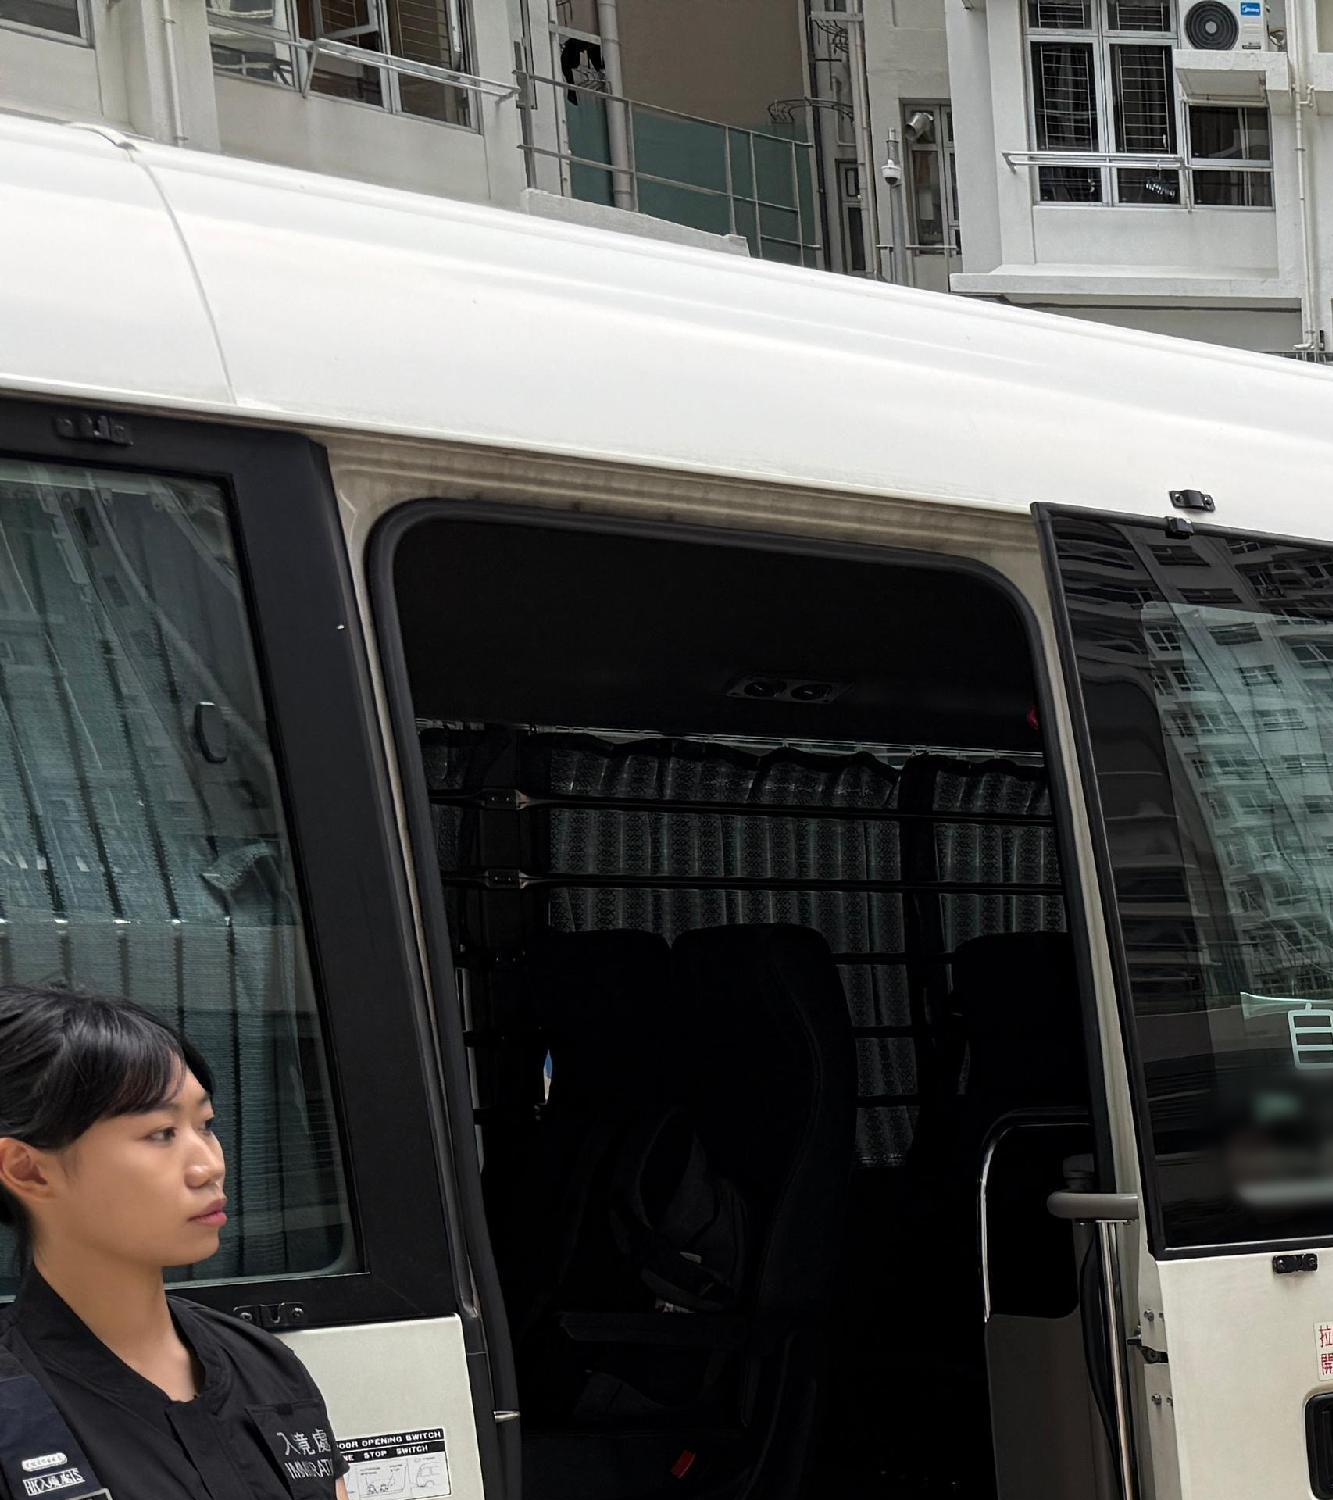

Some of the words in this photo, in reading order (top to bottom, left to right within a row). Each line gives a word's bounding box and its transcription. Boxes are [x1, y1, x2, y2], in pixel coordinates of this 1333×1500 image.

[337, 1439, 360, 1451] OOR
[362, 1435, 403, 1448] OPENING
[405, 1430, 443, 1443] SWITCH
[363, 1450, 389, 1460] STOP
[396, 1445, 429, 1456] SWITCH
